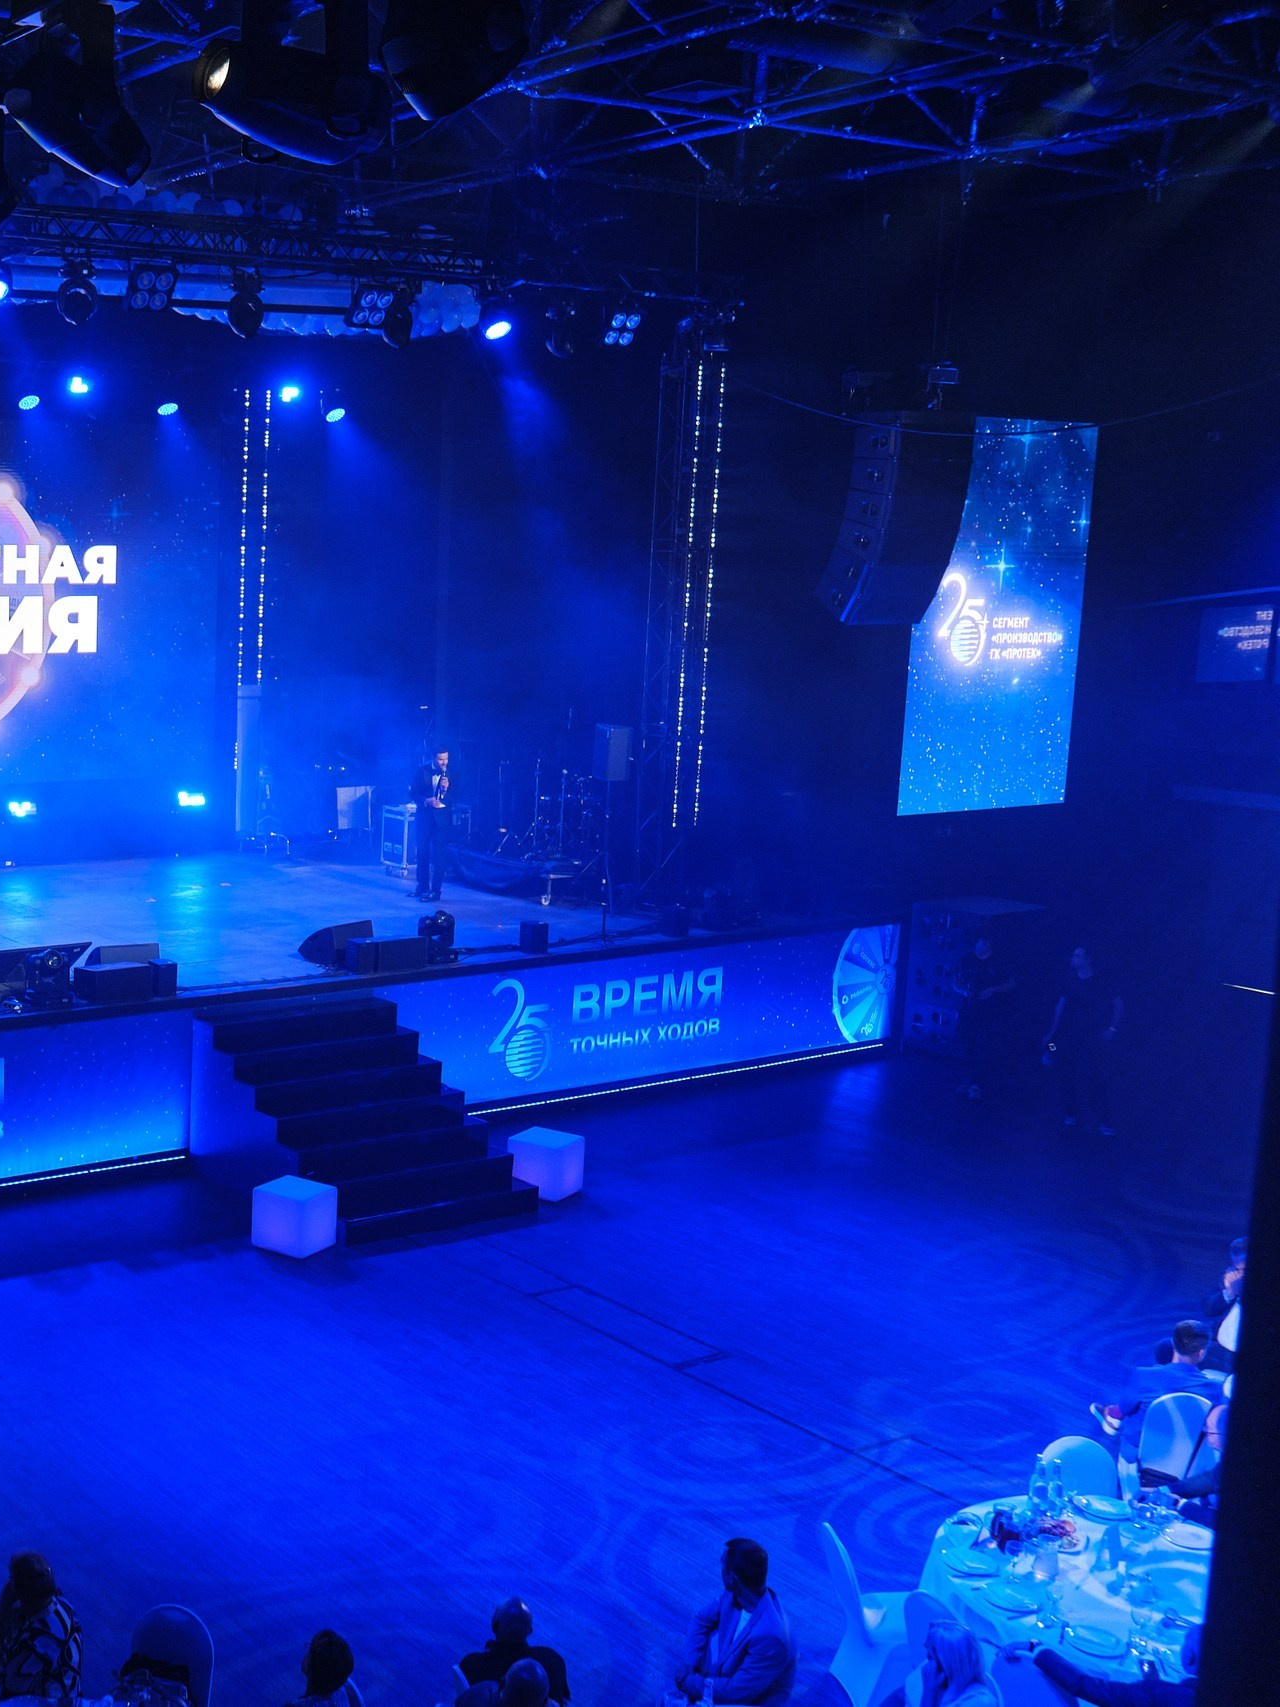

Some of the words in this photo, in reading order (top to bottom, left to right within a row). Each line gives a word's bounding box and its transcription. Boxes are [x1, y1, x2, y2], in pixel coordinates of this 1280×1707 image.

[937, 572, 987, 667] 25
[991, 631, 1063, 645] «ПРОИЗВОДСТВО»
[992, 616, 1030, 629] СЕГМЕНТ
[1001, 648, 1042, 660] «ПРОТЕК»
[572, 966, 724, 1025] ВРЕМЯ
[488, 978, 551, 1081] 25
[569, 1029, 649, 1055] ТОЧНЫХ
[656, 1018, 720, 1042] ХОДОВ
